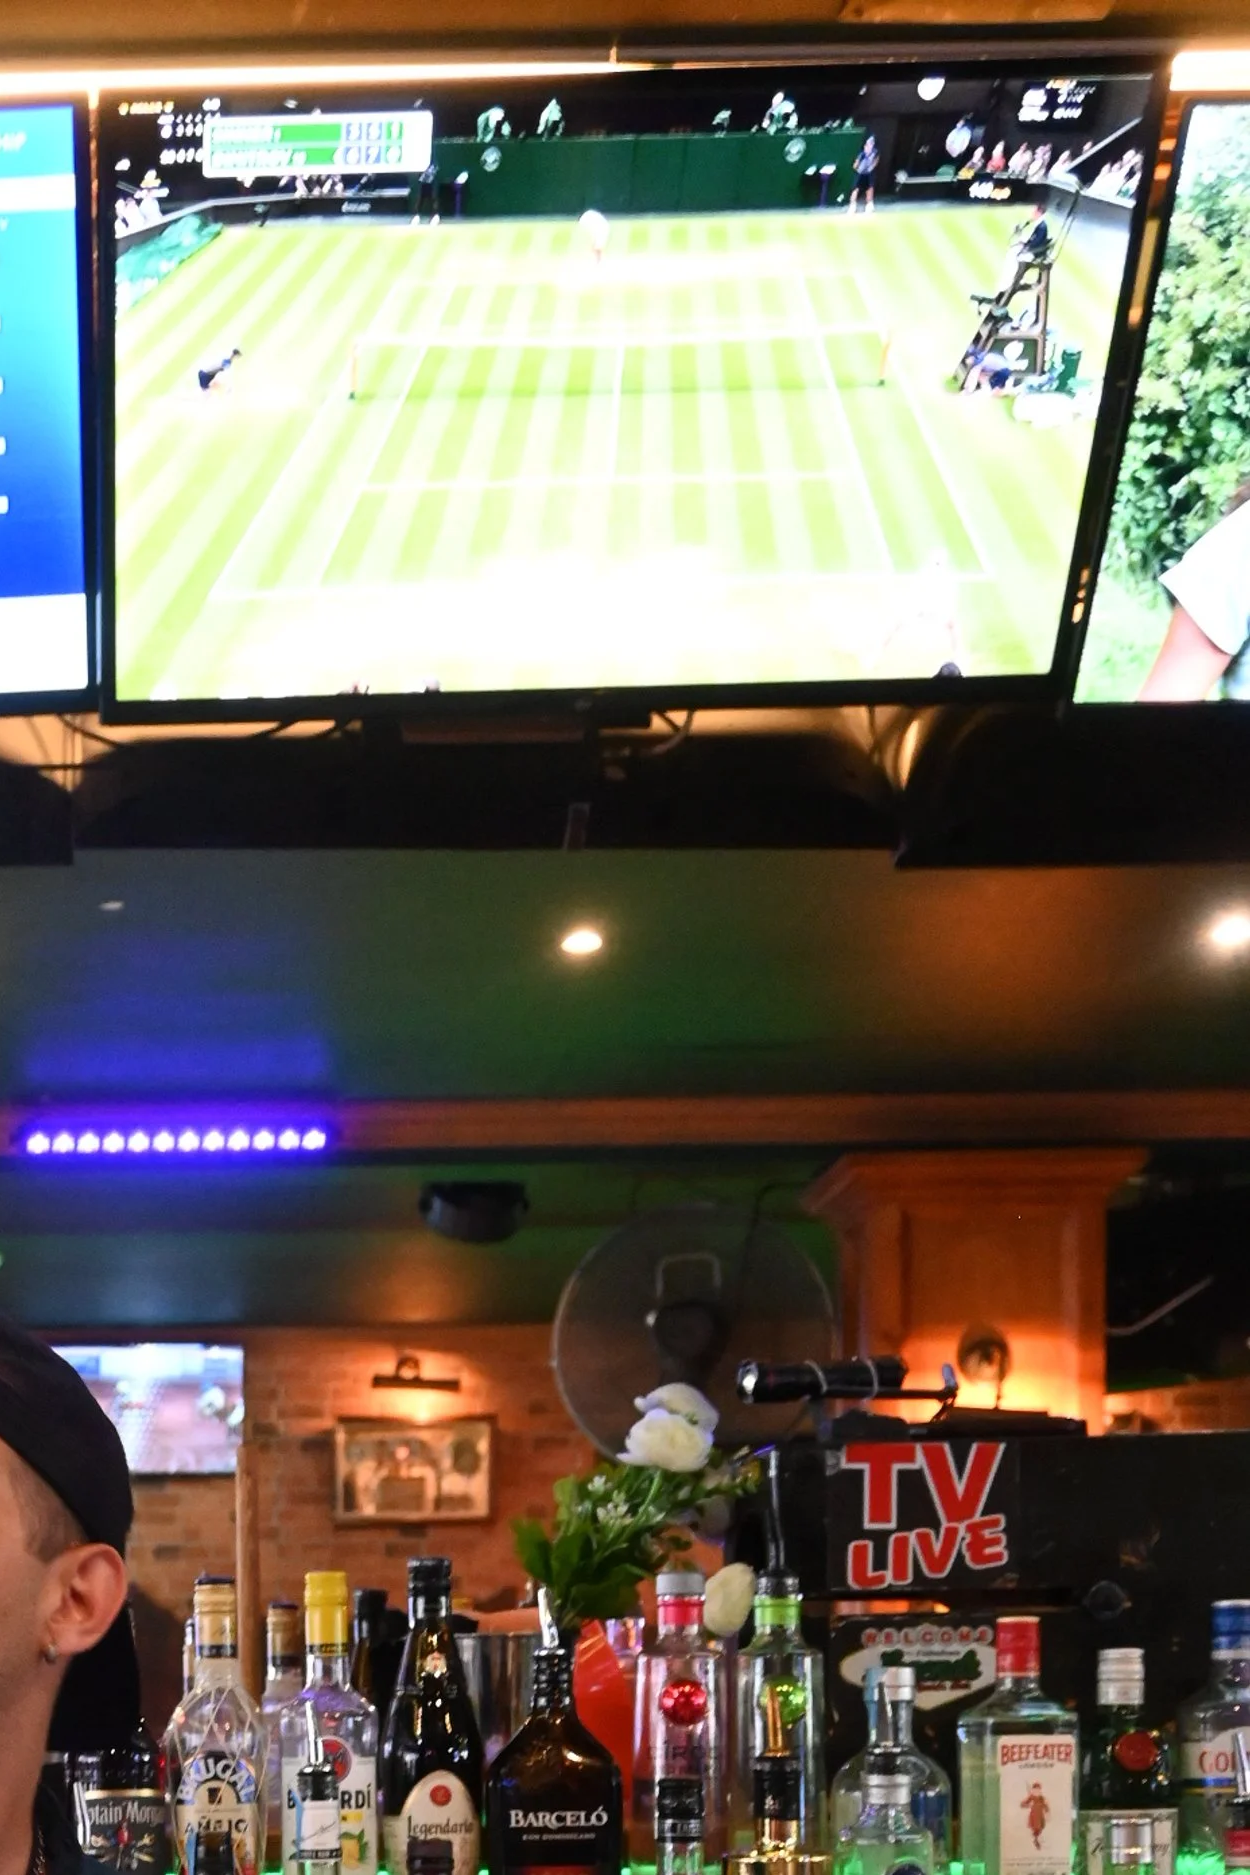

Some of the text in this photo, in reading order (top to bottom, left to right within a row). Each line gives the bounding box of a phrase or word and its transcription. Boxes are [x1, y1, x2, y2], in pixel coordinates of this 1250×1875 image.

[840, 1441, 1006, 1530] TV
[848, 1514, 1008, 1591] LIVE
[862, 1627, 993, 1648] WELCOME
[1001, 1742, 1073, 1766] BEEFEATER
[510, 1805, 608, 1830] BARCELÓ
